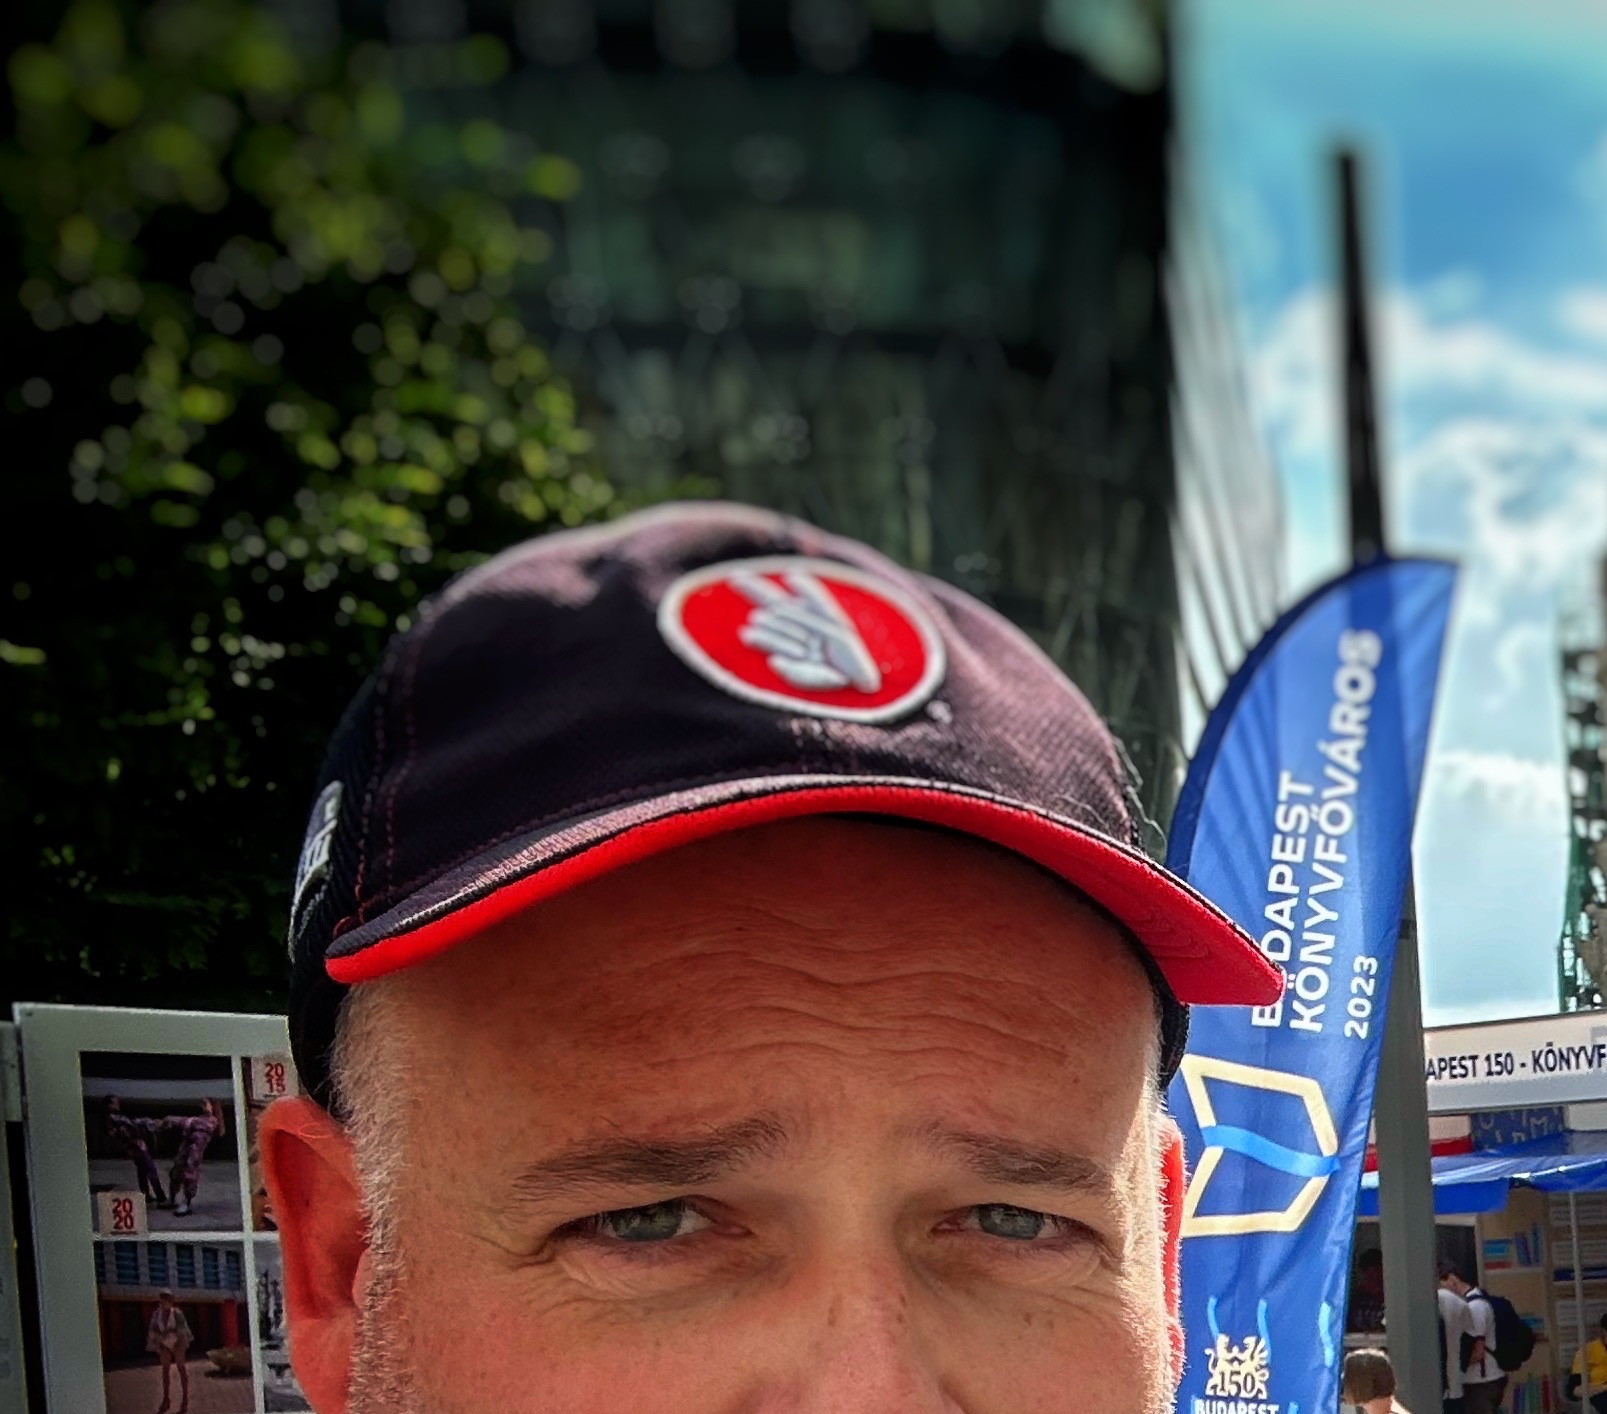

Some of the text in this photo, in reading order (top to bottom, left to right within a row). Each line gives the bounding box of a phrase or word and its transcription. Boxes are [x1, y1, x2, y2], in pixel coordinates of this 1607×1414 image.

[1286, 629, 1382, 1034] KÖNYVFŐVÁROS
[1252, 770, 1316, 1027] BDAPEST
[1344, 955, 1378, 1040] 2023
[264, 1062, 285, 1078] 20
[1484, 1053, 1514, 1077] 150
[112, 1198, 133, 1213] 20
[113, 1214, 134, 1230] 20
[1218, 1370, 1256, 1396] 150
